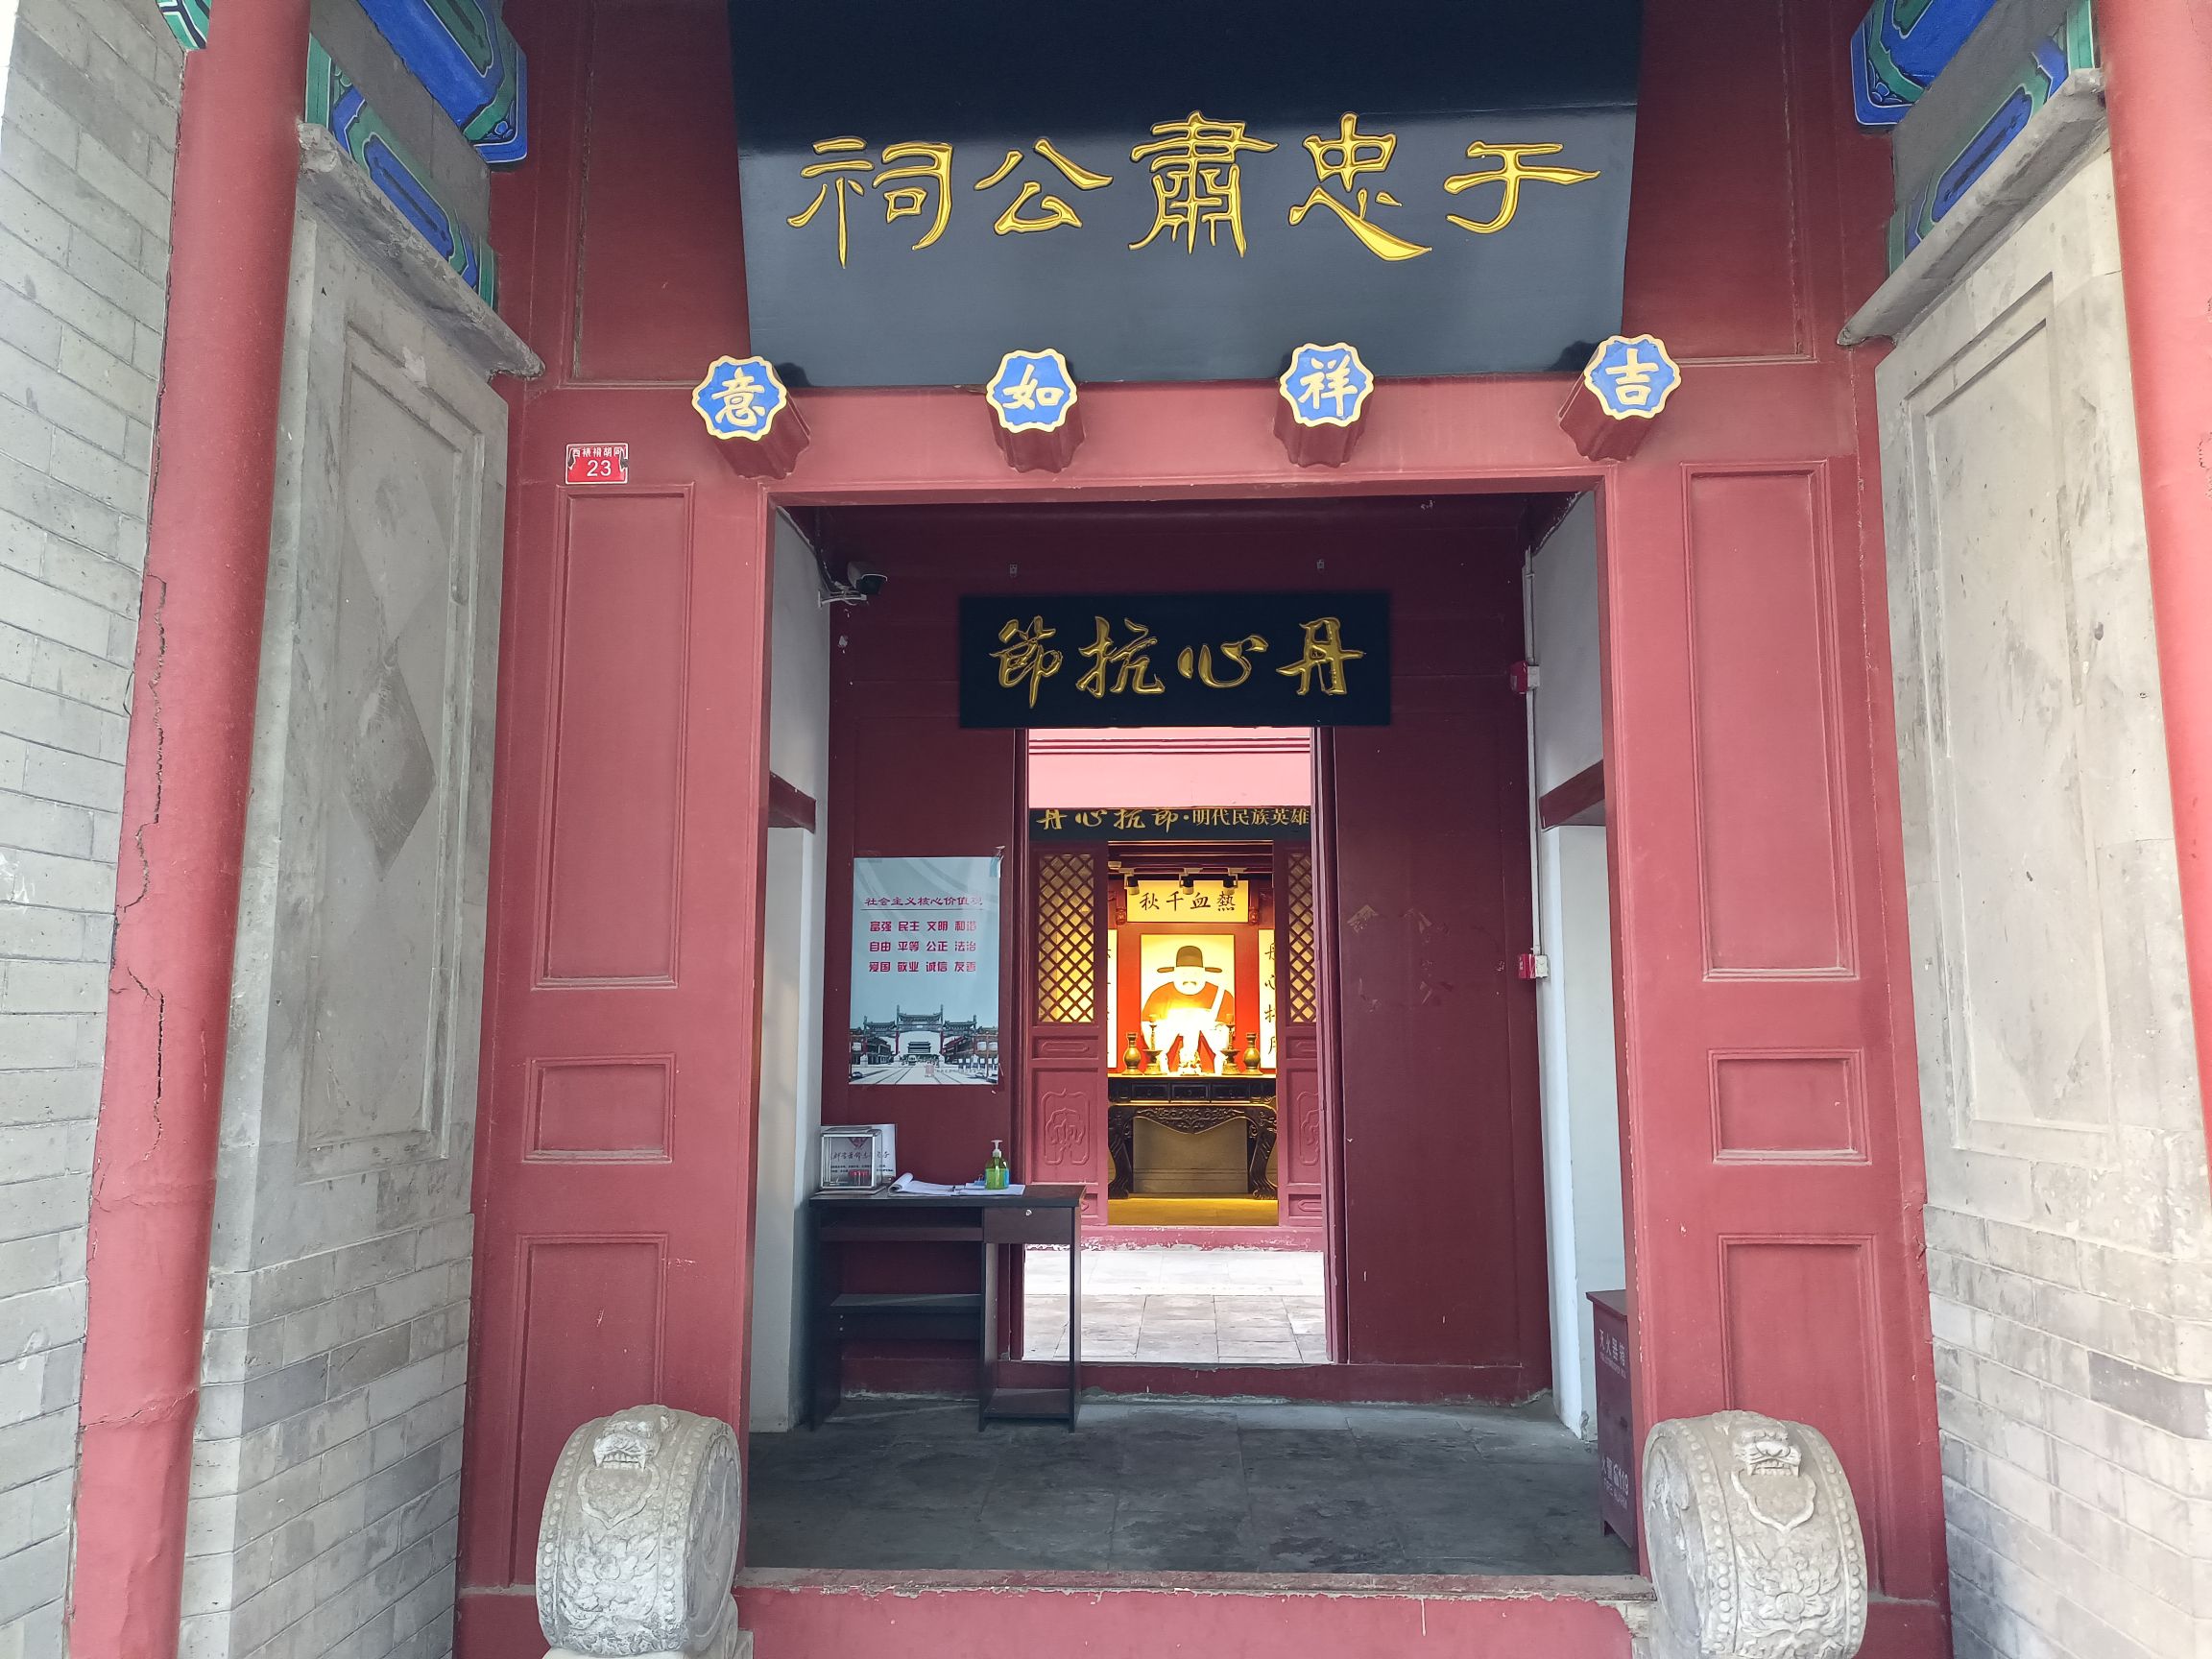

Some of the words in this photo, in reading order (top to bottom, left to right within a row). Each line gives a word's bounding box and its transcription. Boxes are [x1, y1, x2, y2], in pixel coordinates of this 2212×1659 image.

[586, 459, 613, 477] 23
[870, 921, 892, 932] 富强
[898, 921, 920, 932] 民主
[926, 921, 949, 932] 文明
[869, 941, 891, 952] 自由
[898, 941, 920, 952] 平等
[926, 941, 948, 952] 公正
[954, 941, 976, 952] 法治
[868, 961, 891, 973] 爱国
[897, 961, 919, 973] 敬业
[926, 961, 948, 973] 诚信
[953, 961, 976, 973] 友善
